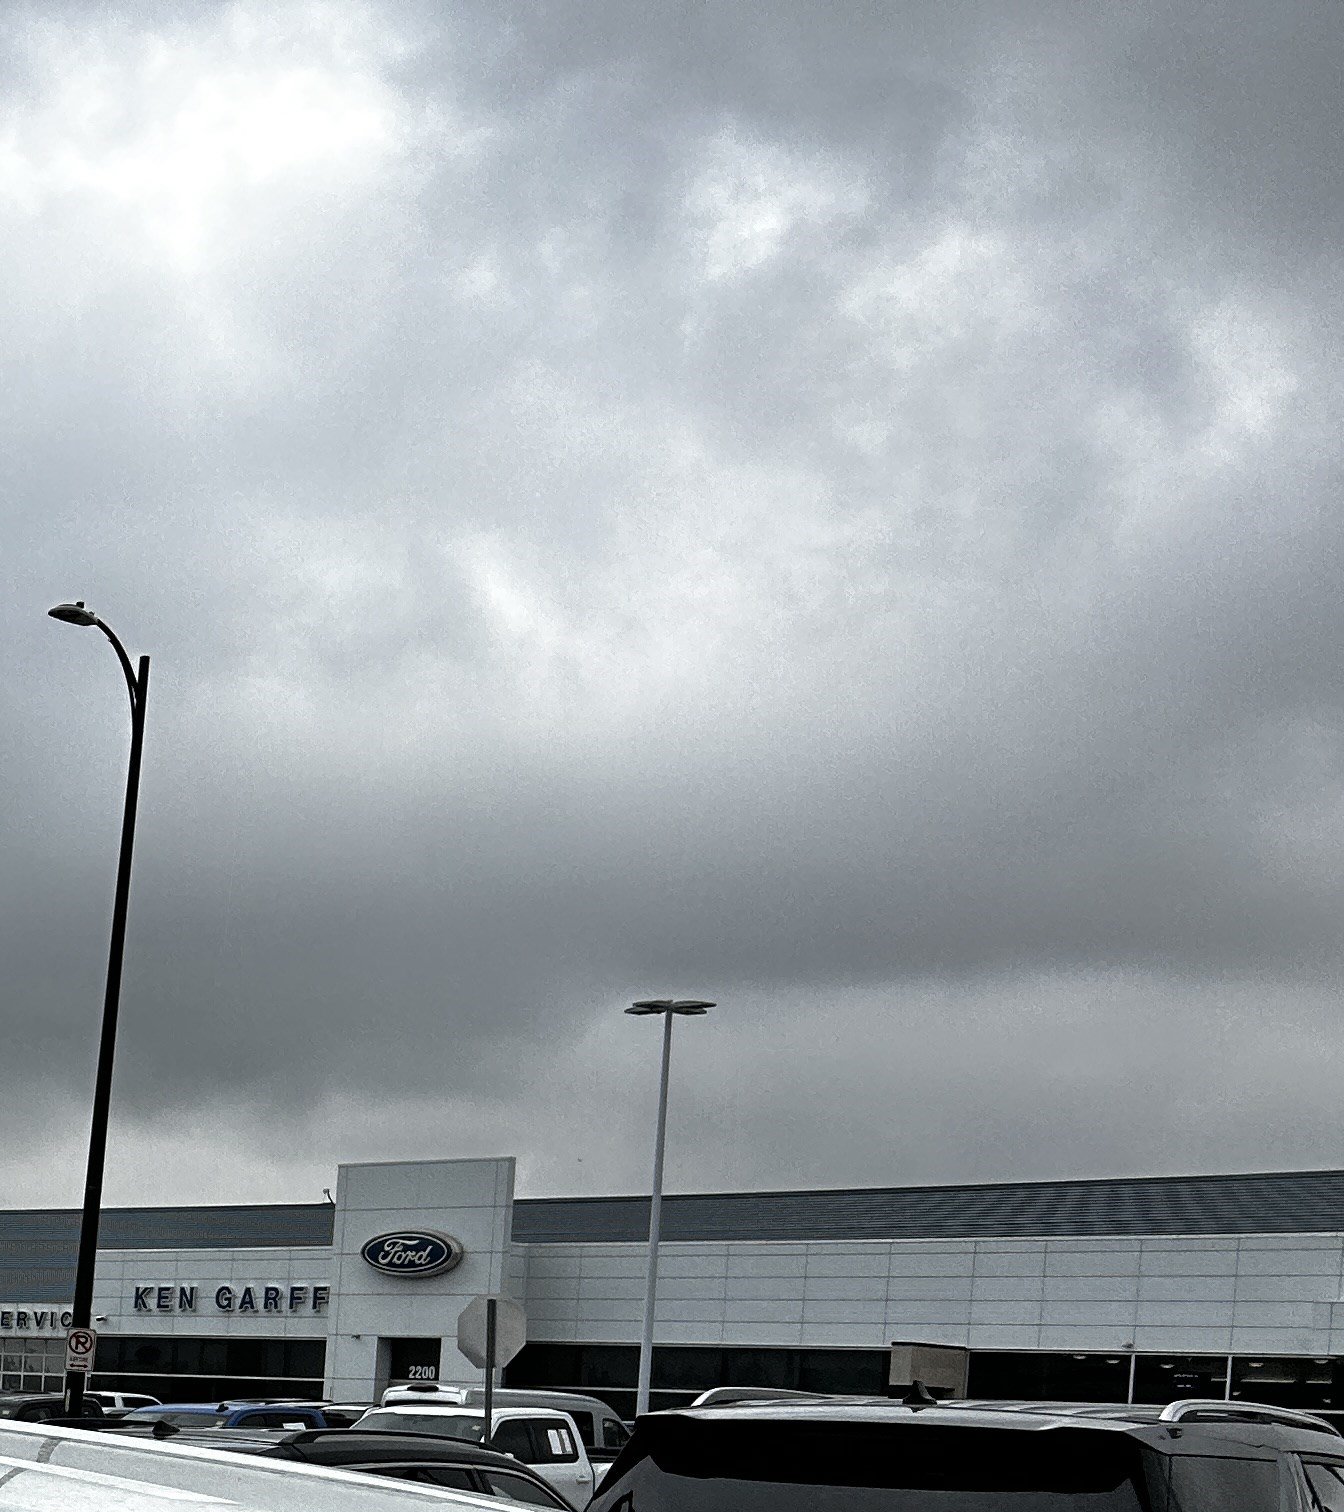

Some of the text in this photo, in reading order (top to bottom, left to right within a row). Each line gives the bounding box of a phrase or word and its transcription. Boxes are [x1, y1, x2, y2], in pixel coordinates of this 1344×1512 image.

[377, 1238, 434, 1266] Ford
[133, 1285, 331, 1312] KEN GARFF
[408, 1365, 436, 1380] 2200
